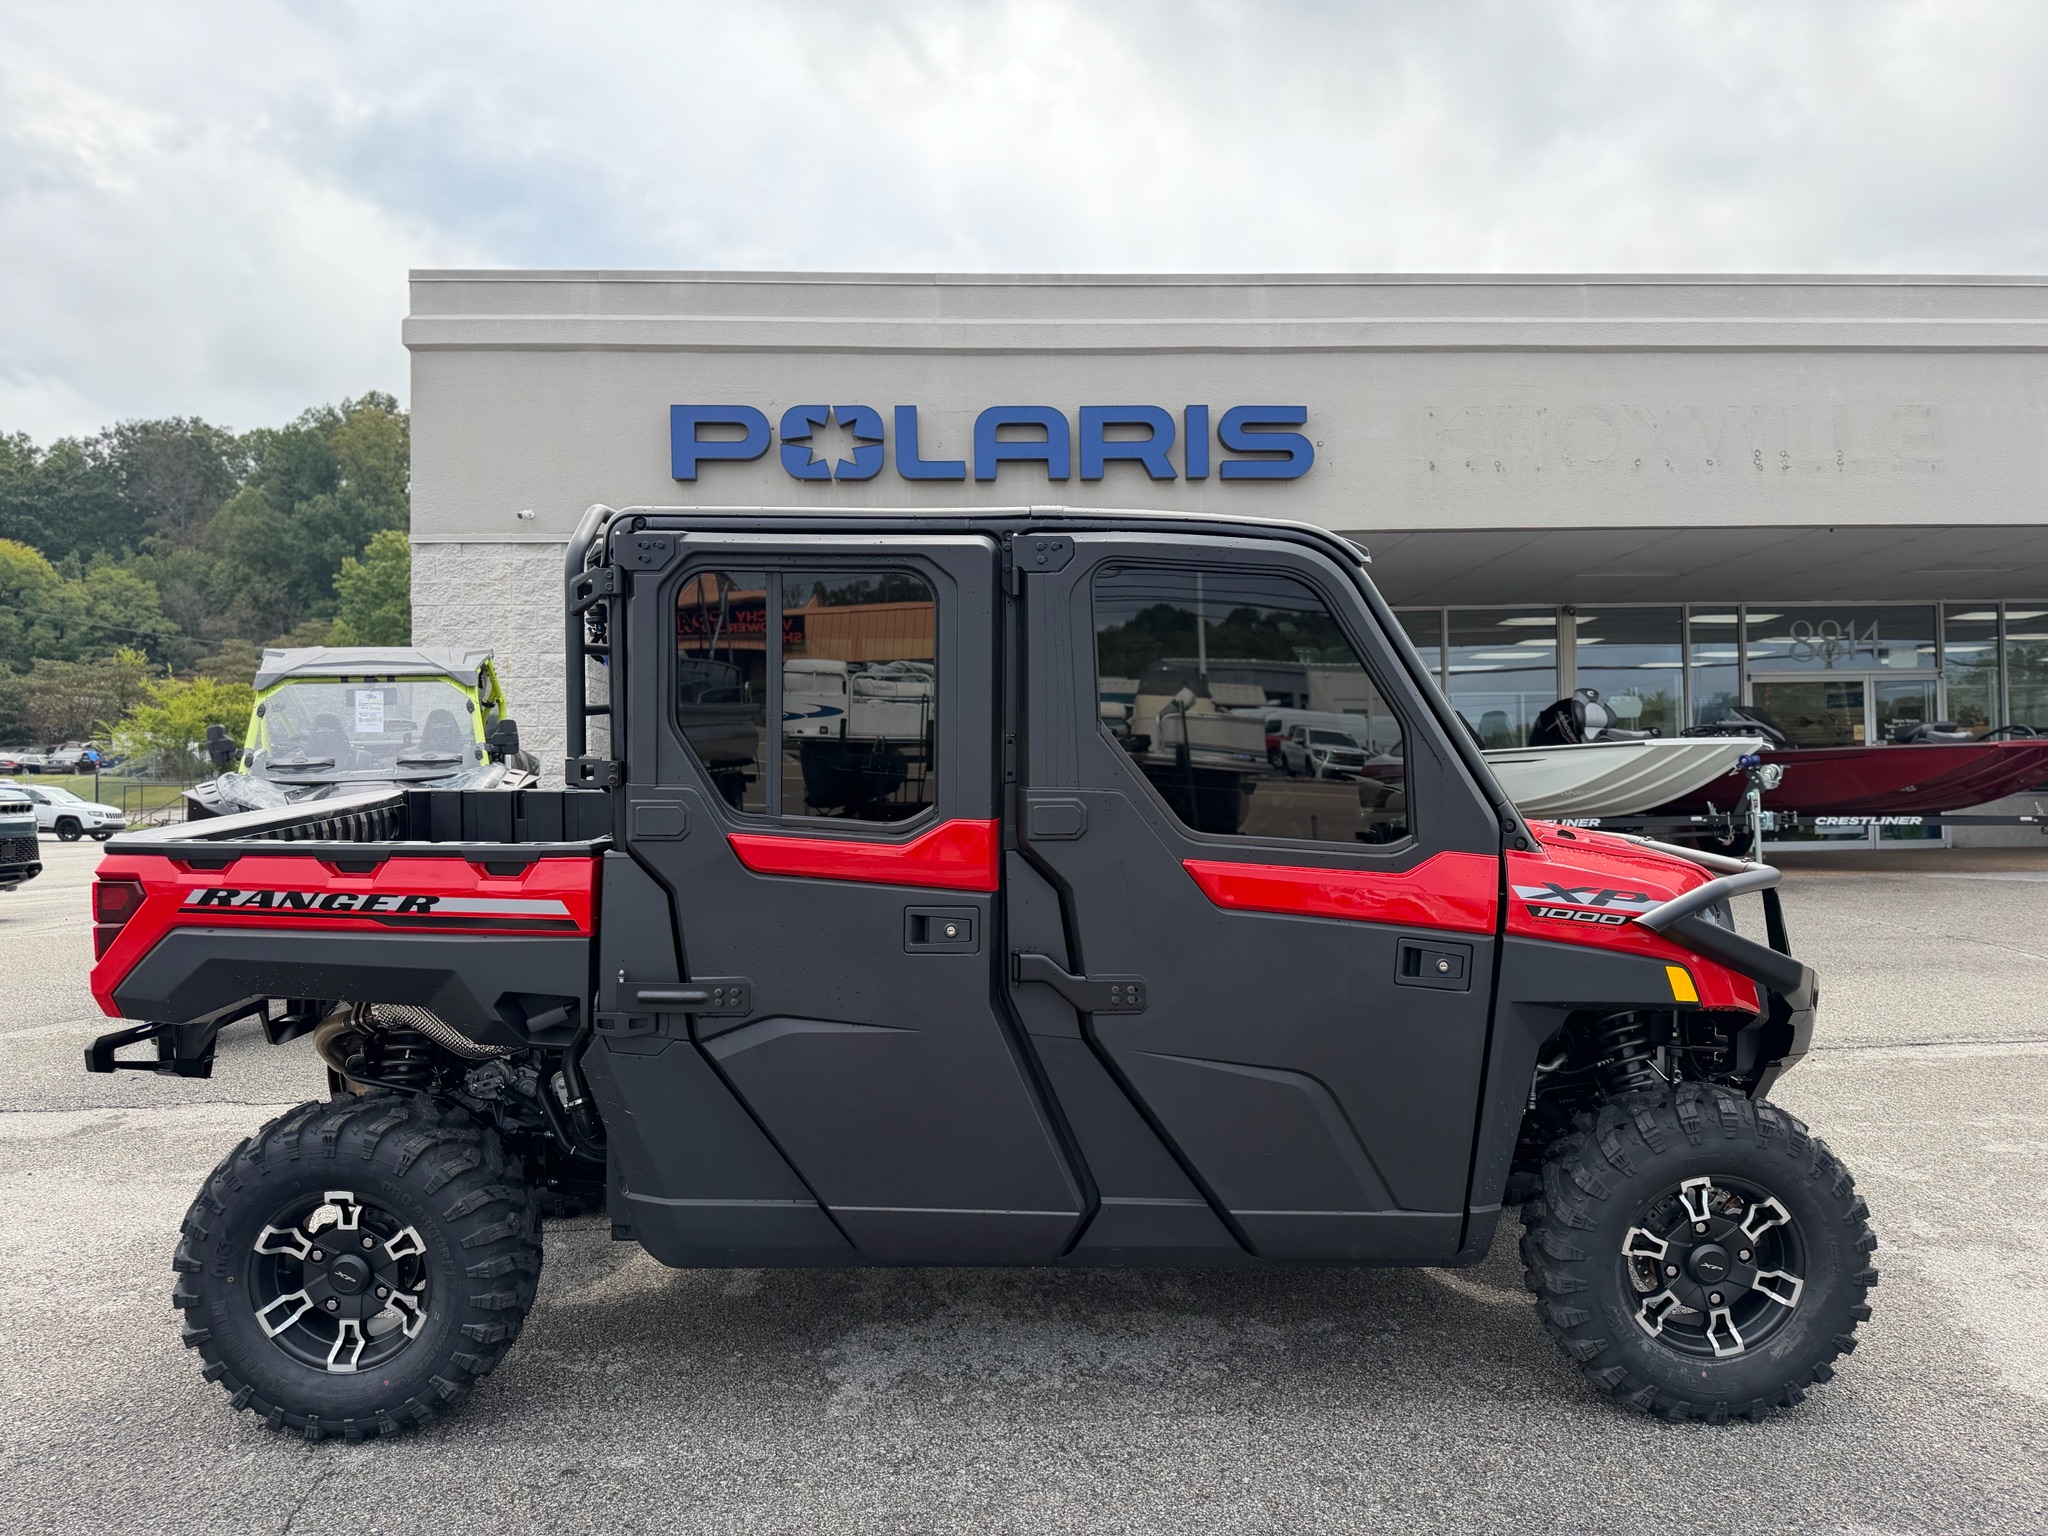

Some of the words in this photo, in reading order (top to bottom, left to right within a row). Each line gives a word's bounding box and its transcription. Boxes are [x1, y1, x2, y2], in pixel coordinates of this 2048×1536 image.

[670, 405, 1315, 482] POLARIS
[1789, 618, 1883, 662] 8814
[1815, 816, 1923, 826] CRESTLINER
[195, 888, 440, 914] RANGER
[1524, 881, 1651, 907] XP
[1536, 907, 1626, 926] 1000
[382, 1180, 412, 1204] PRO
[414, 1205, 450, 1259] ARMOR
